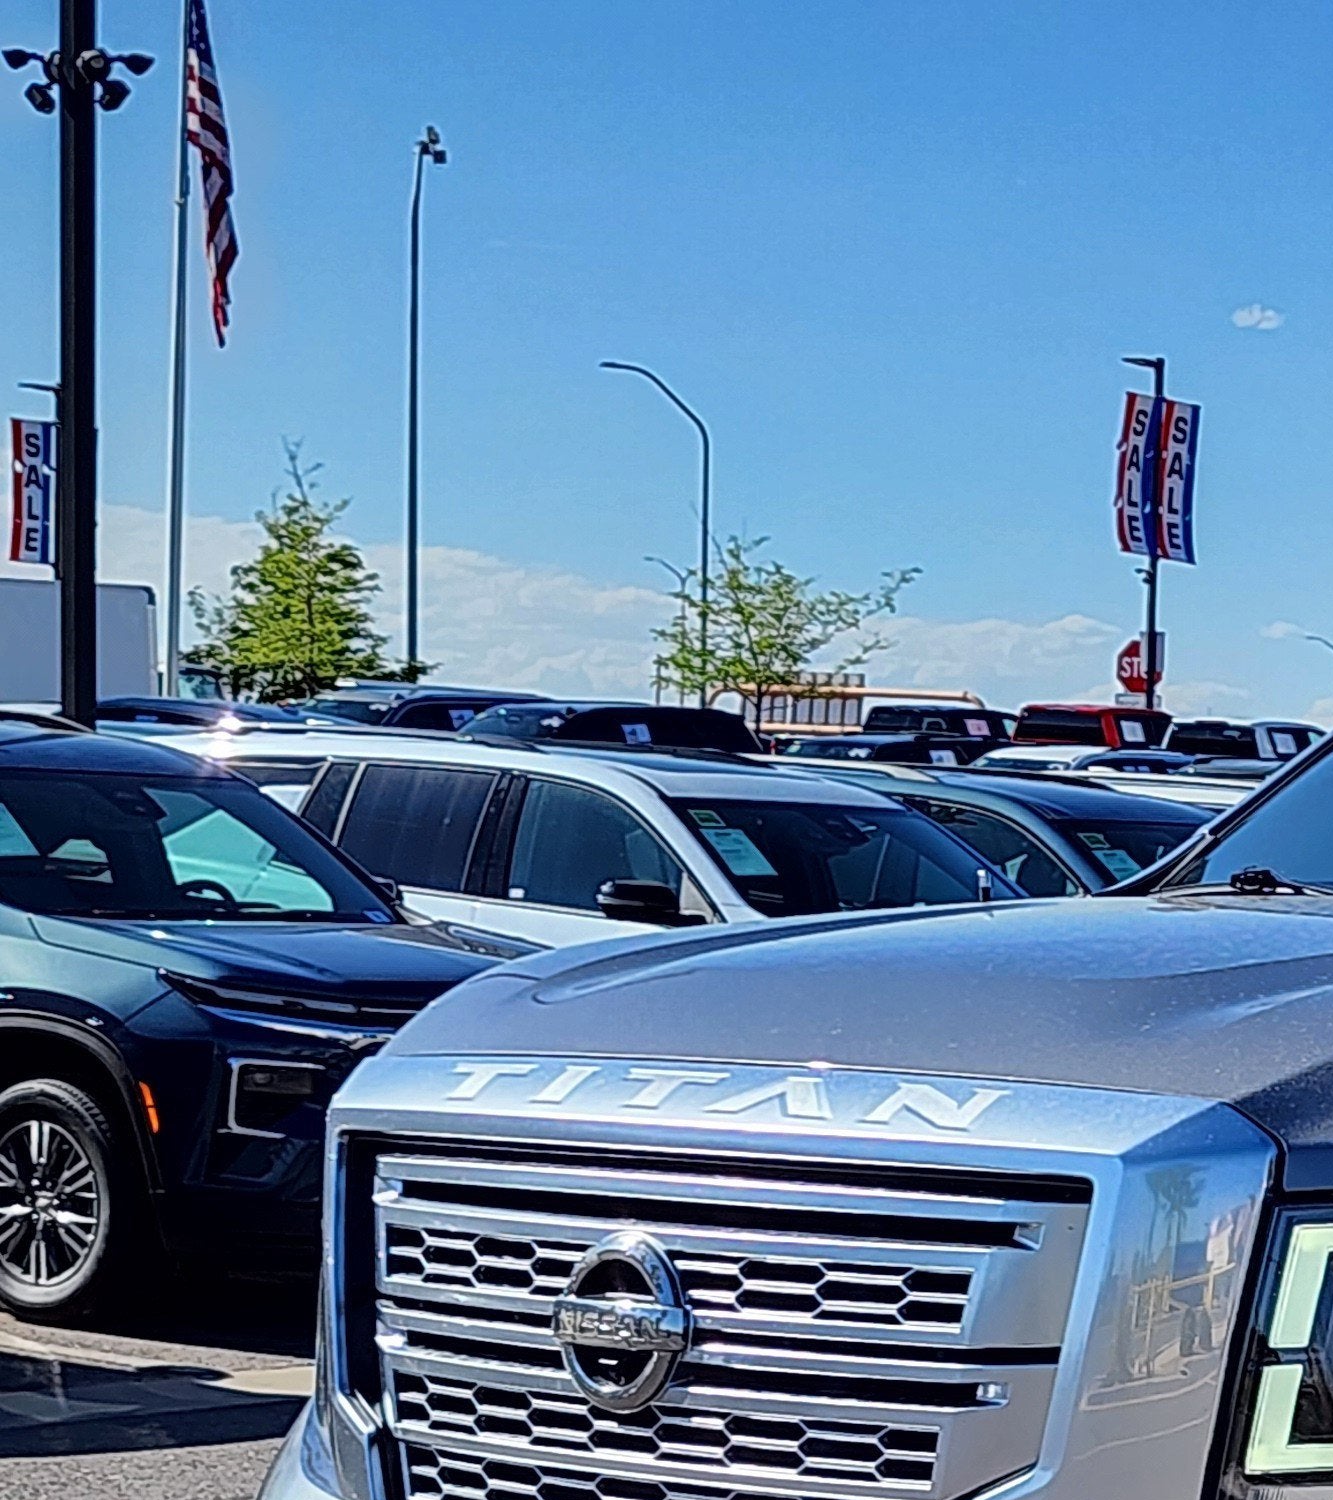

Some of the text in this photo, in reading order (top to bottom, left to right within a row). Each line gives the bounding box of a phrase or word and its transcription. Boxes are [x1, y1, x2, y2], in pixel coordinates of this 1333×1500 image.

[24, 432, 44, 552] SALE
[1126, 408, 1149, 544] SALE
[1166, 415, 1189, 551] SALE
[1120, 656, 1149, 680] ST
[446, 1062, 1010, 1130] TITAN
[557, 1306, 666, 1341] NISSAN
